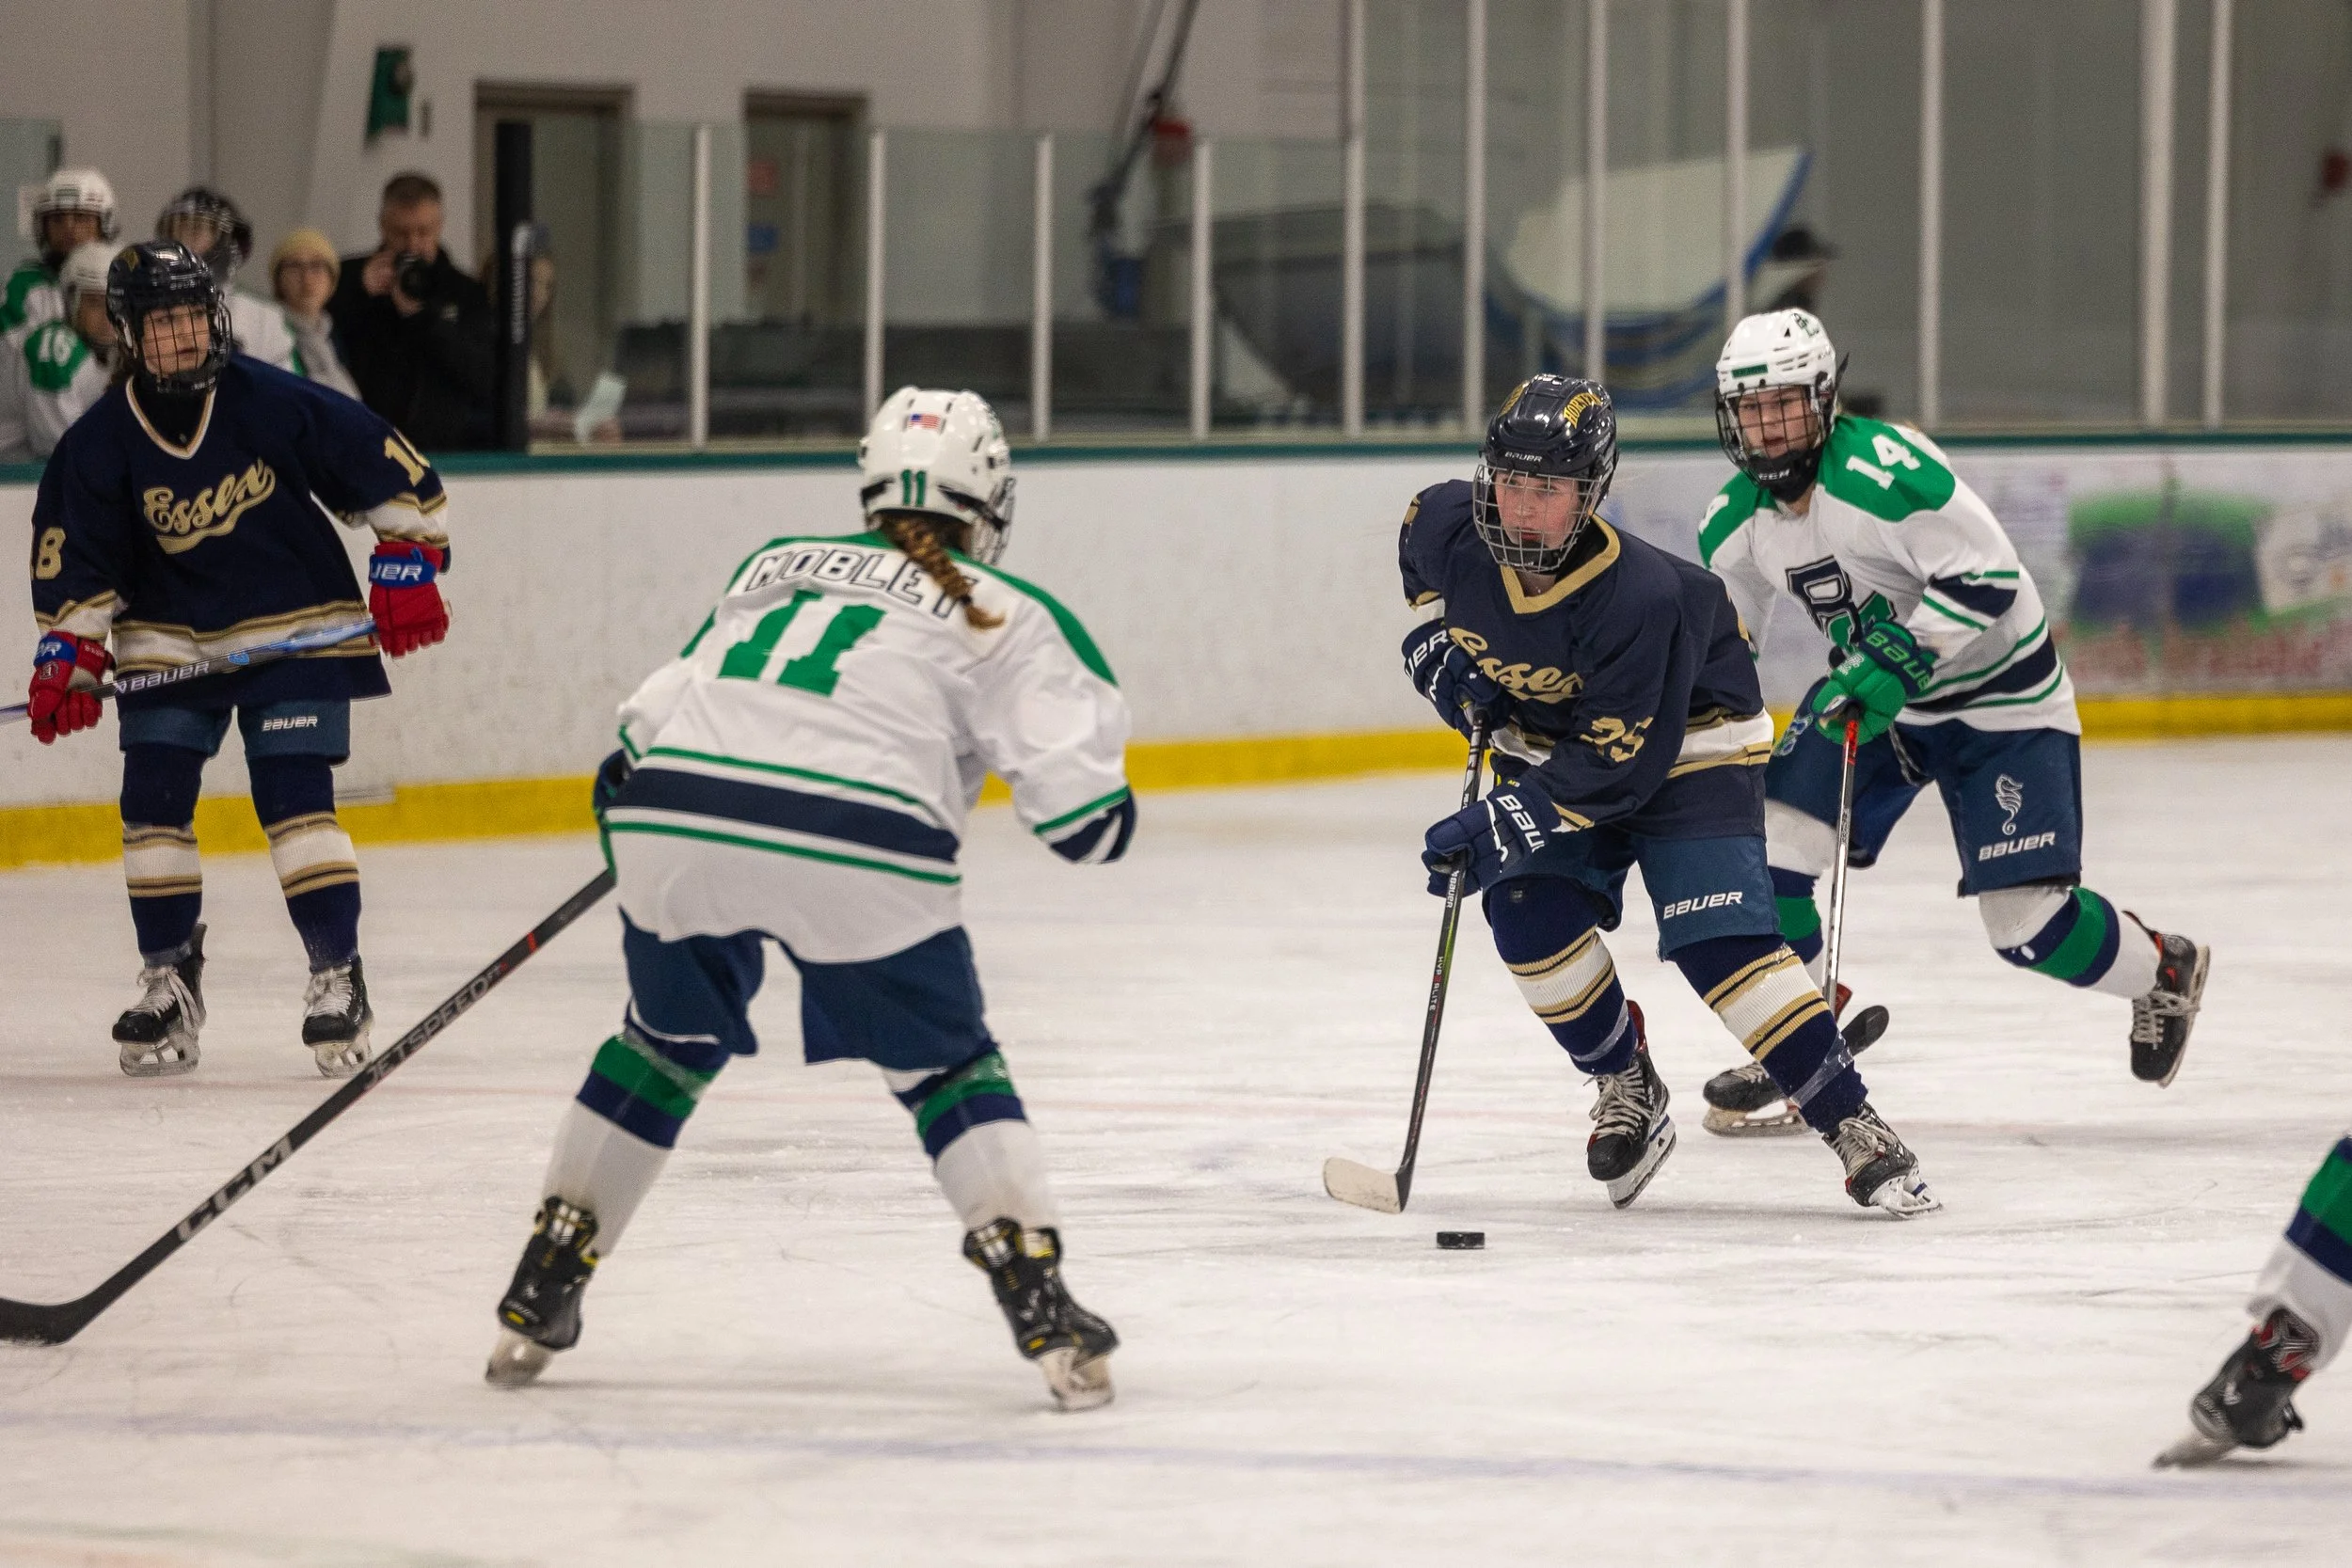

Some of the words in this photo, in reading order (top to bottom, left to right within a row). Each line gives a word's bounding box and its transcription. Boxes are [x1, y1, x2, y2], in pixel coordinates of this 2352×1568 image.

[384, 428, 431, 487] 1
[1504, 451, 1543, 462] BAUER
[1845, 434, 1922, 491] 14
[143, 456, 277, 536] Essex
[900, 468, 927, 507] 11
[30, 526, 67, 580] 8
[716, 589, 888, 698] 11
[130, 661, 210, 692] BAUER
[262, 716, 319, 732] BAUER
[1497, 794, 1546, 853] BAU
[1979, 832, 2057, 862] BAUER
[1445, 877, 1458, 909] BAUER
[1662, 891, 1743, 920] BAUER
[363, 974, 489, 1085] JETSPEED
[177, 1134, 293, 1242] CCM
